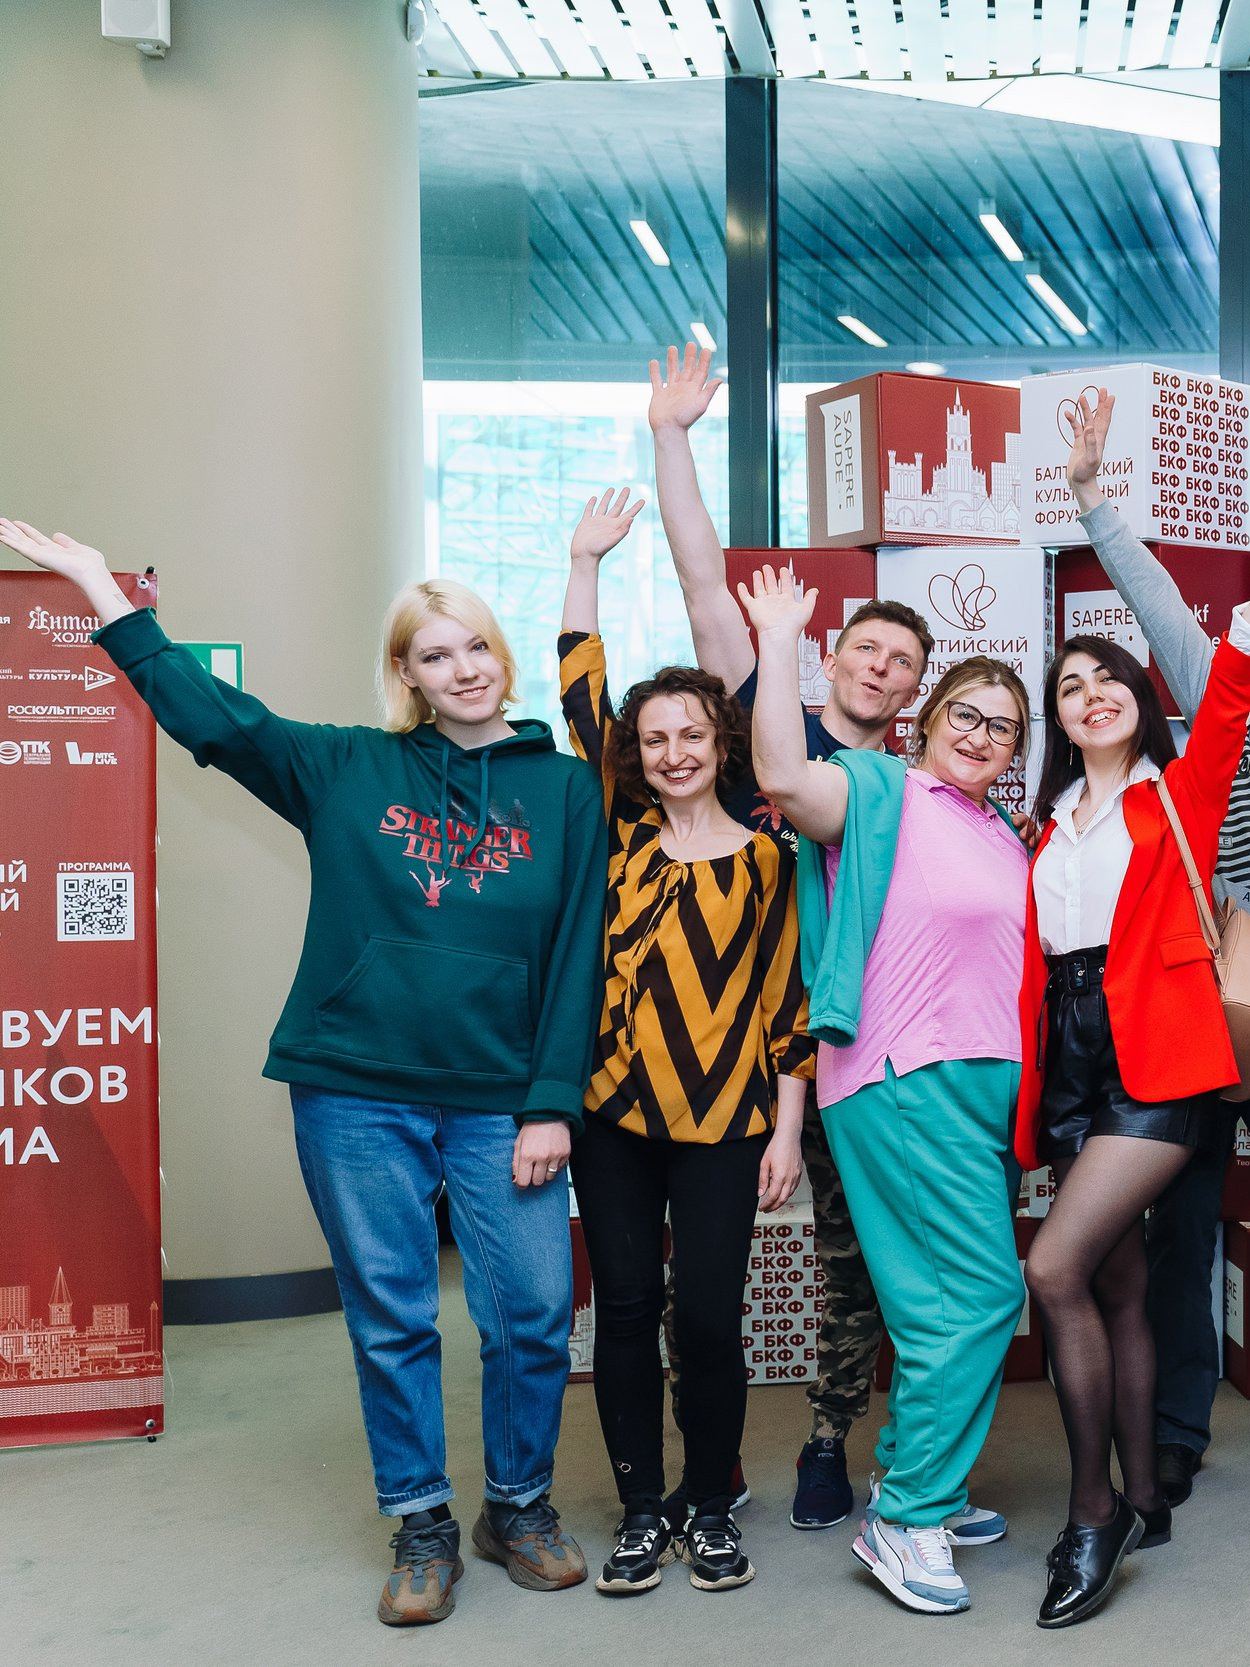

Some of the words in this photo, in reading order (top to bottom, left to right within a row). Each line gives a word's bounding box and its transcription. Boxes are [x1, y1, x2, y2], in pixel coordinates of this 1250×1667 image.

[1153, 372, 1180, 389] БКФ
[1187, 379, 1212, 396] БКФ
[1219, 386, 1243, 402] БКФ
[1160, 390, 1187, 407] БКФ
[1194, 397, 1219, 413] БКФ
[1225, 404, 1249, 419] БКФ
[1152, 405, 1180, 421] БКФ
[1187, 411, 1212, 427] БКФ
[1219, 418, 1242, 433] БКФ
[1160, 422, 1187, 438] БКФ
[1193, 428, 1218, 444] БКФ
[1225, 434, 1248, 450] БКФ
[833, 414, 844, 484] AUDE
[1152, 438, 1179, 453] БКФ
[1186, 444, 1212, 459] БКФ
[1218, 449, 1242, 464] БКФ
[843, 410, 855, 509] SAPERE
[1159, 455, 1186, 470] БКФ
[1193, 460, 1218, 476] БКФ
[1225, 466, 1248, 481] БКФ
[1152, 472, 1179, 488] БКФ
[1186, 477, 1212, 492] БКФ
[1218, 482, 1242, 497] БКФ
[1160, 490, 1187, 505] БКФ
[1194, 495, 1219, 510] БКФ
[1226, 500, 1249, 514] БКФ
[1152, 505, 1180, 520] БКФ
[1186, 509, 1212, 524] БКФ
[1218, 514, 1242, 528] БКФ
[1162, 523, 1188, 538] БКФ
[1195, 528, 1220, 542] БКФ
[1227, 532, 1249, 546] БКФ
[1072, 608, 1134, 628] SAPERE
[29, 673, 84, 681] КУЛЬТУРА
[8, 705, 116, 716] РОСКУЛЬТПРОЕКТ
[20, 740, 51, 754] ТТК
[988, 785, 1024, 799] БКФ
[58, 862, 132, 872] ПРОГРАММА
[2, 1006, 153, 1048] ВУЕМ
[752, 1225, 792, 1238] БКФ
[762, 1240, 803, 1254] БКФ
[752, 1256, 792, 1269] БКФ
[762, 1270, 803, 1284] БКФ
[752, 1286, 793, 1300] БКФ
[762, 1301, 804, 1315] БКФ
[752, 1318, 793, 1332] БКФ
[764, 1333, 806, 1347] БКФ
[752, 1349, 794, 1363] БКФ
[766, 1365, 807, 1379] БКФ
